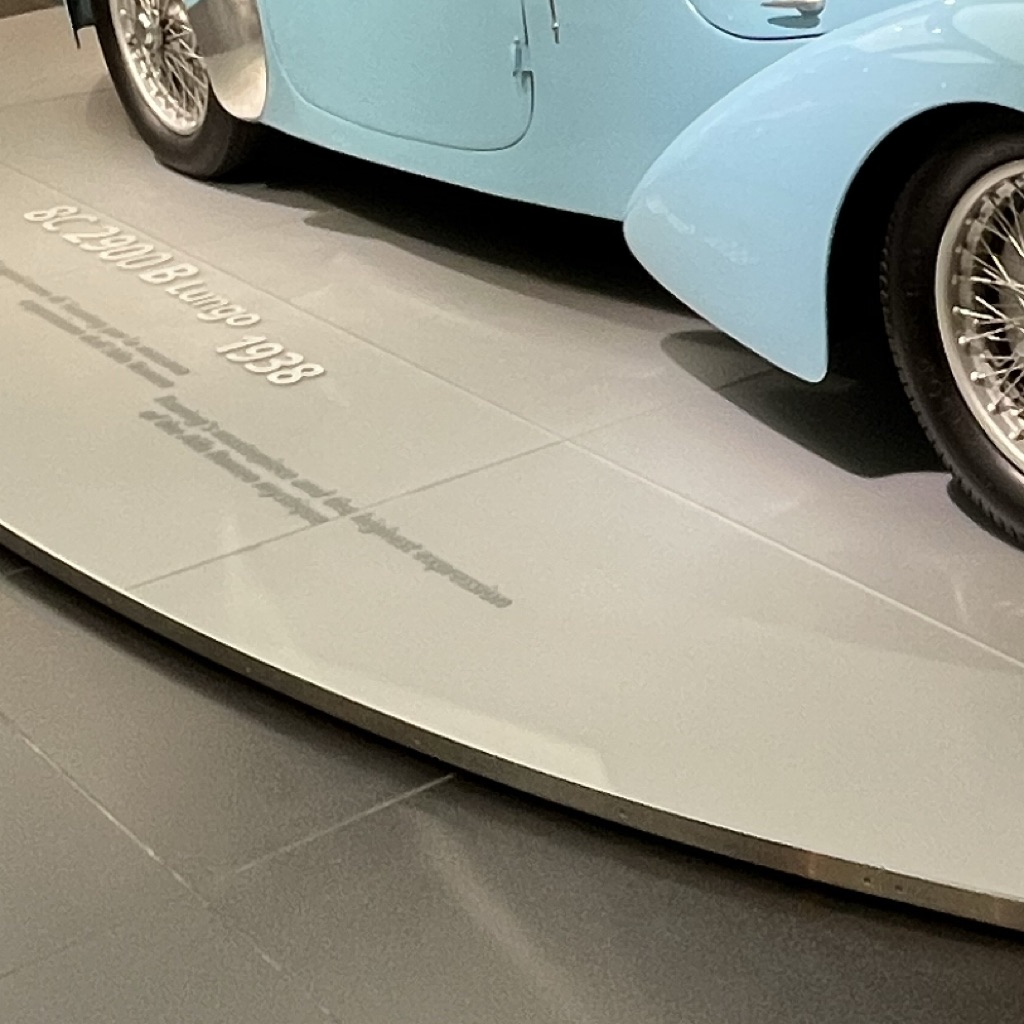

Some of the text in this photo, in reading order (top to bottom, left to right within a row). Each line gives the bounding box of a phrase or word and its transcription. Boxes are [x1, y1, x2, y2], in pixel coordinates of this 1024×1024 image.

[23, 205, 98, 232] 8C
[60, 226, 173, 270] 2900
[138, 262, 199, 285] B
[164, 280, 262, 325] Lungo
[215, 334, 326, 385] 1938
